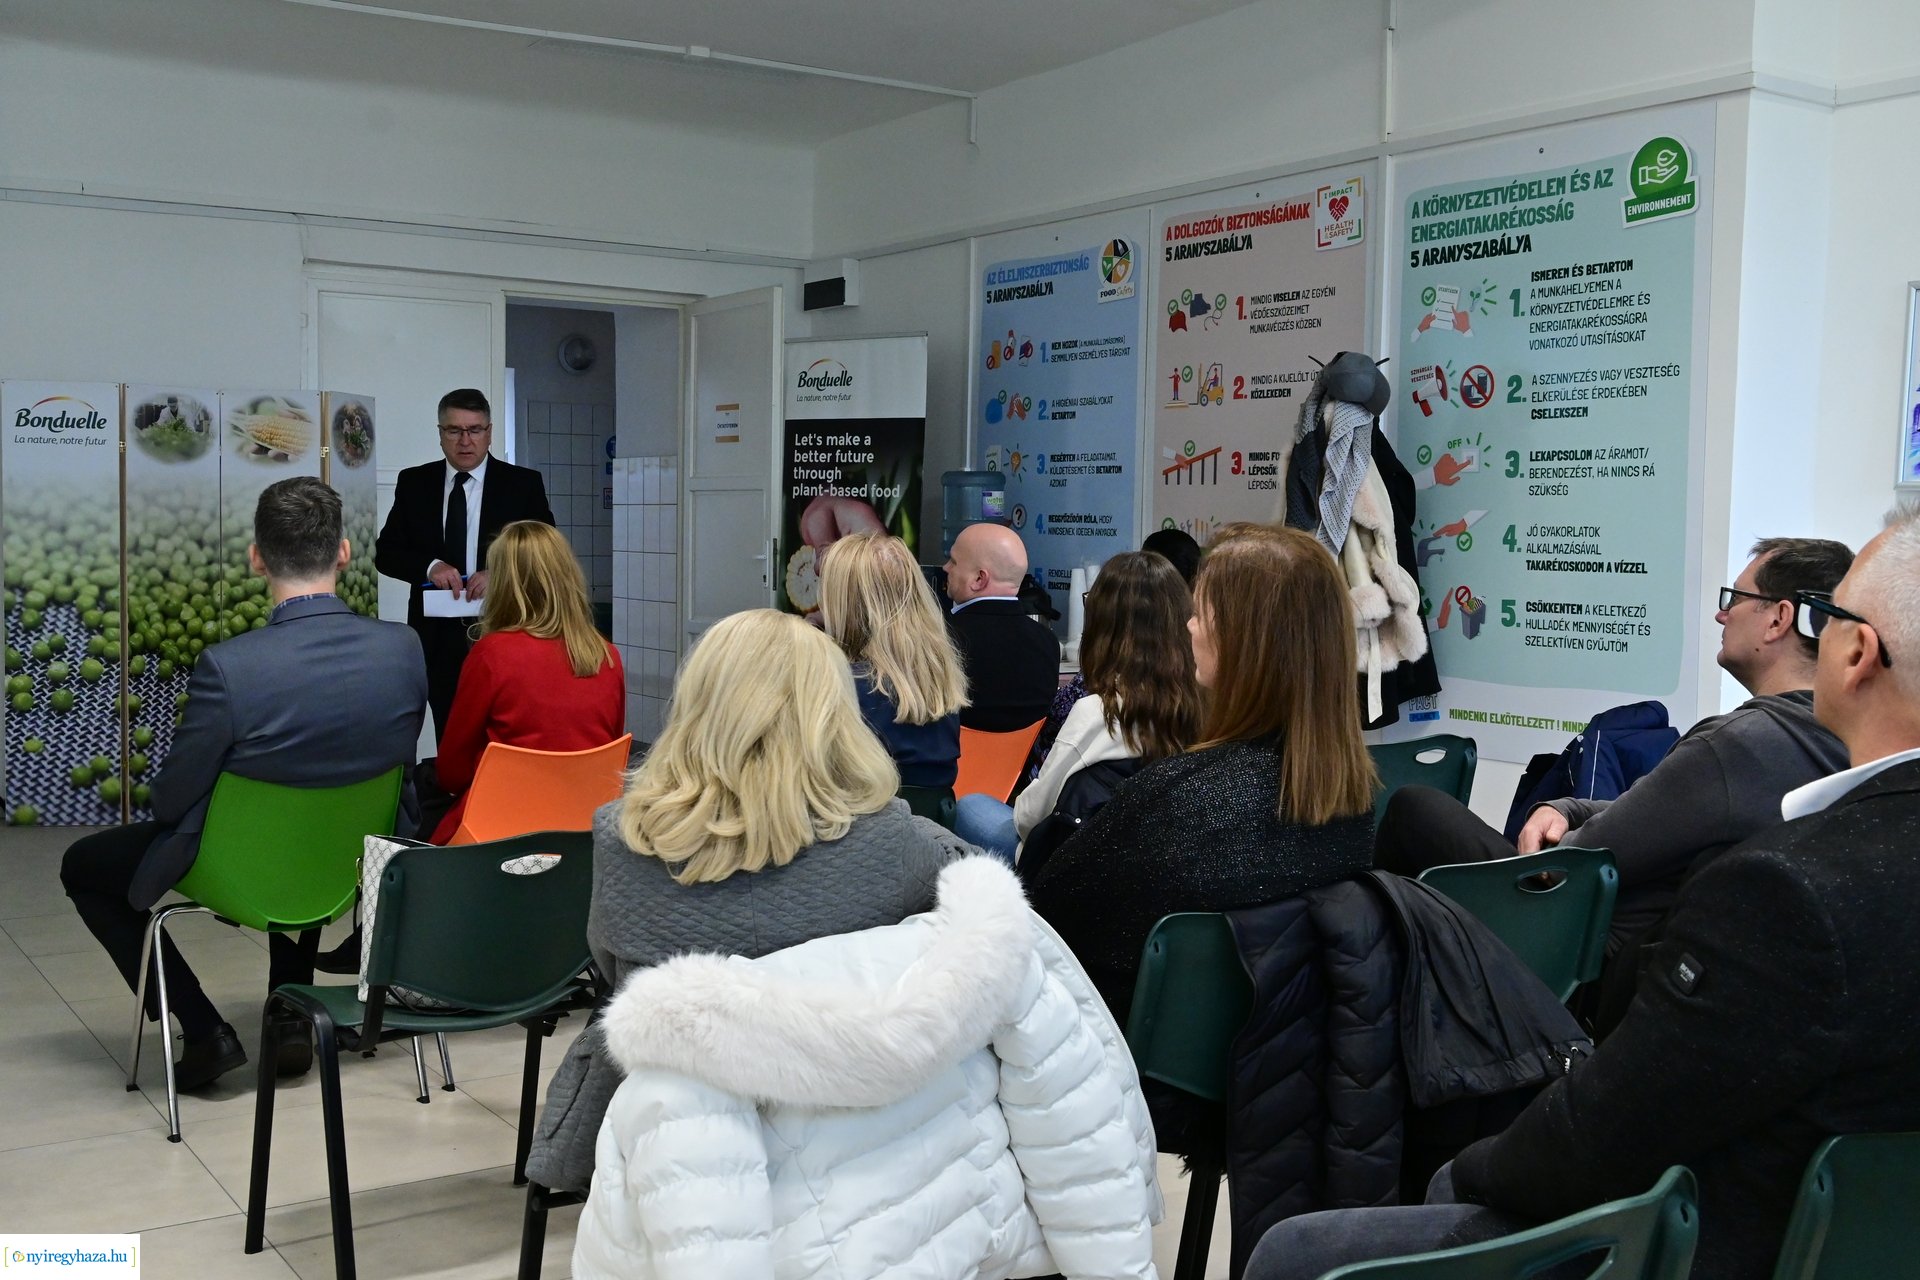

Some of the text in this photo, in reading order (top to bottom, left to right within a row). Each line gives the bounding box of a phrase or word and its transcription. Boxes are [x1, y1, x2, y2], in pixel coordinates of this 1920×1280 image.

[1329, 187, 1352, 198] IMPACT
[1411, 167, 1614, 219] A KÖRNYEZETVÉDELEM ÉS AZ
[1627, 194, 1692, 216] ENVIRONNEMENT
[1166, 202, 1311, 241] A DOLGOZÓK BIZTONSÁGÁNAK
[1325, 220, 1354, 232] HEALTH
[1411, 199, 1574, 243] ENERGIATAKARÉKOSSÁG
[1329, 227, 1354, 238] SAFETY
[1165, 234, 1253, 262] 5 ARANYSZABÁLYA
[1410, 233, 1532, 268] 5 ARANYSZABÁLYA
[987, 254, 1090, 286] AZ ÉLELMISZERBIZTONSÁG
[1531, 259, 1633, 282] ISMEREM ÉS BETARTOM
[987, 280, 1054, 304] 5 ARANYSZABÁLYA
[1100, 289, 1117, 298] FOOD
[1251, 286, 1336, 305] MINDIG VISELEM AZ EGYÉNI
[1530, 279, 1622, 299] A MUNKAHELYEMEN A
[1235, 295, 1248, 321] 1.
[1509, 288, 1526, 318] 1.
[1530, 293, 1651, 317] KÖRNYEZETVÉDELEMRE ÉS
[1250, 318, 1322, 334] MUNKAVÉGZÉS KÖZBEN
[1529, 313, 1648, 334] ENERGIATAKARÉKOSSÁGRA
[1529, 329, 1646, 351] VONATKOZÓ UTASÍTÁSOKAT
[797, 370, 853, 392] Bonduelle
[1251, 374, 1272, 385] MINDIG
[1273, 374, 1278, 384] A
[1532, 363, 1680, 386] A SZENNYEZÉS VAGY VESZTESÉG
[823, 393, 838, 401] notre
[838, 392, 852, 403] futur
[1233, 375, 1248, 400] 2.
[1251, 387, 1292, 400] KÖZLEKEDEM
[1507, 374, 1527, 404] 2.
[1532, 382, 1648, 403] ELKERÜLÉSE ÉRDEKÉBEN
[15, 408, 107, 433] Bonduelle
[1531, 406, 1589, 420] CSELEKSZEM
[14, 435, 107, 447] La nature, notre futur
[795, 432, 872, 447] Let's make a
[1447, 438, 1462, 449] OFF
[794, 449, 875, 463] better future
[1231, 451, 1246, 475] 3.
[1248, 451, 1270, 461] MINDIG
[1529, 445, 1649, 462] LEKAPCSOLOM AZ ÁRAMOT/
[793, 466, 842, 483] through
[1504, 450, 1524, 479] 3.
[1529, 462, 1655, 479] BERENDEZÉST, HA NINCS RÁ
[792, 483, 900, 499] plant-based food
[1528, 481, 1569, 496] SZÜKSÉG
[1502, 524, 1522, 553] 4.
[1526, 523, 1601, 538] JÓ GYAKORLATOK
[1526, 539, 1602, 555] ALKALMAZÁSÁVAL
[1526, 557, 1648, 574] TAKARÉKOSKODOM A VÍZZEL
[1501, 599, 1521, 628] 5.
[1526, 599, 1647, 618] CSÖKKENTEM A KELETKEZŐ
[1525, 618, 1651, 636] HULLADÉK MENNYISÉGÉT ÉS
[1525, 633, 1628, 653] SZELEKTÍVEN GYŰJTÖM
[1449, 708, 1487, 723] MINDENKI
[1490, 712, 1555, 730] ELKÖTELEZETT
